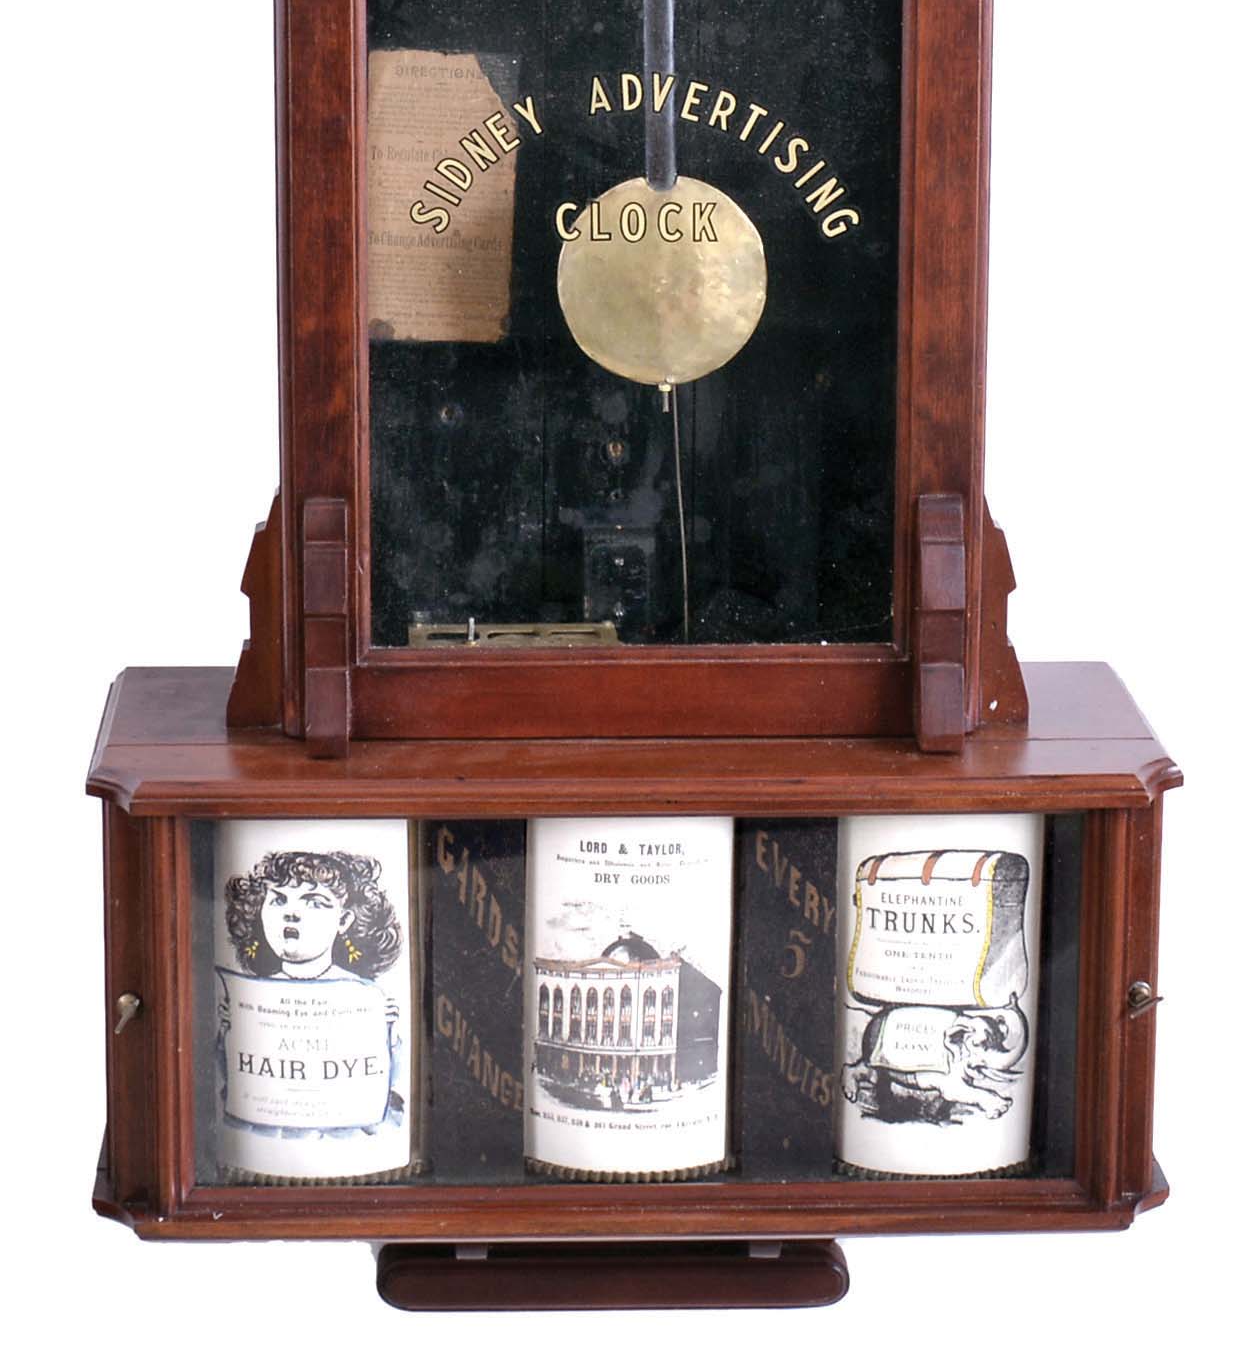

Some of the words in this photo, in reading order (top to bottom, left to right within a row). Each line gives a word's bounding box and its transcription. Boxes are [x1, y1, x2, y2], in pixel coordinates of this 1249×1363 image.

[410, 95, 544, 234] SIDNEY
[589, 72, 861, 240] ADVERTISING
[555, 202, 719, 242] CLOCK
[580, 840, 607, 854] LORD
[618, 844, 628, 854] &
[594, 873, 620, 884] DRY
[631, 875, 670, 884] GOODS
[756, 830, 835, 934] EVERY
[437, 826, 518, 968] CARDS
[881, 892, 963, 906] ELEPHANTINE
[867, 907, 980, 934] TRUNKS.
[781, 929, 811, 978] 5
[258, 1005, 290, 1017] Beaming
[437, 994, 523, 1112] CHANGE
[748, 990, 832, 1107] MINUTES
[239, 1052, 306, 1080] HAIR
[323, 1056, 384, 1080] DYE.
[609, 1122, 631, 1130] Grand
